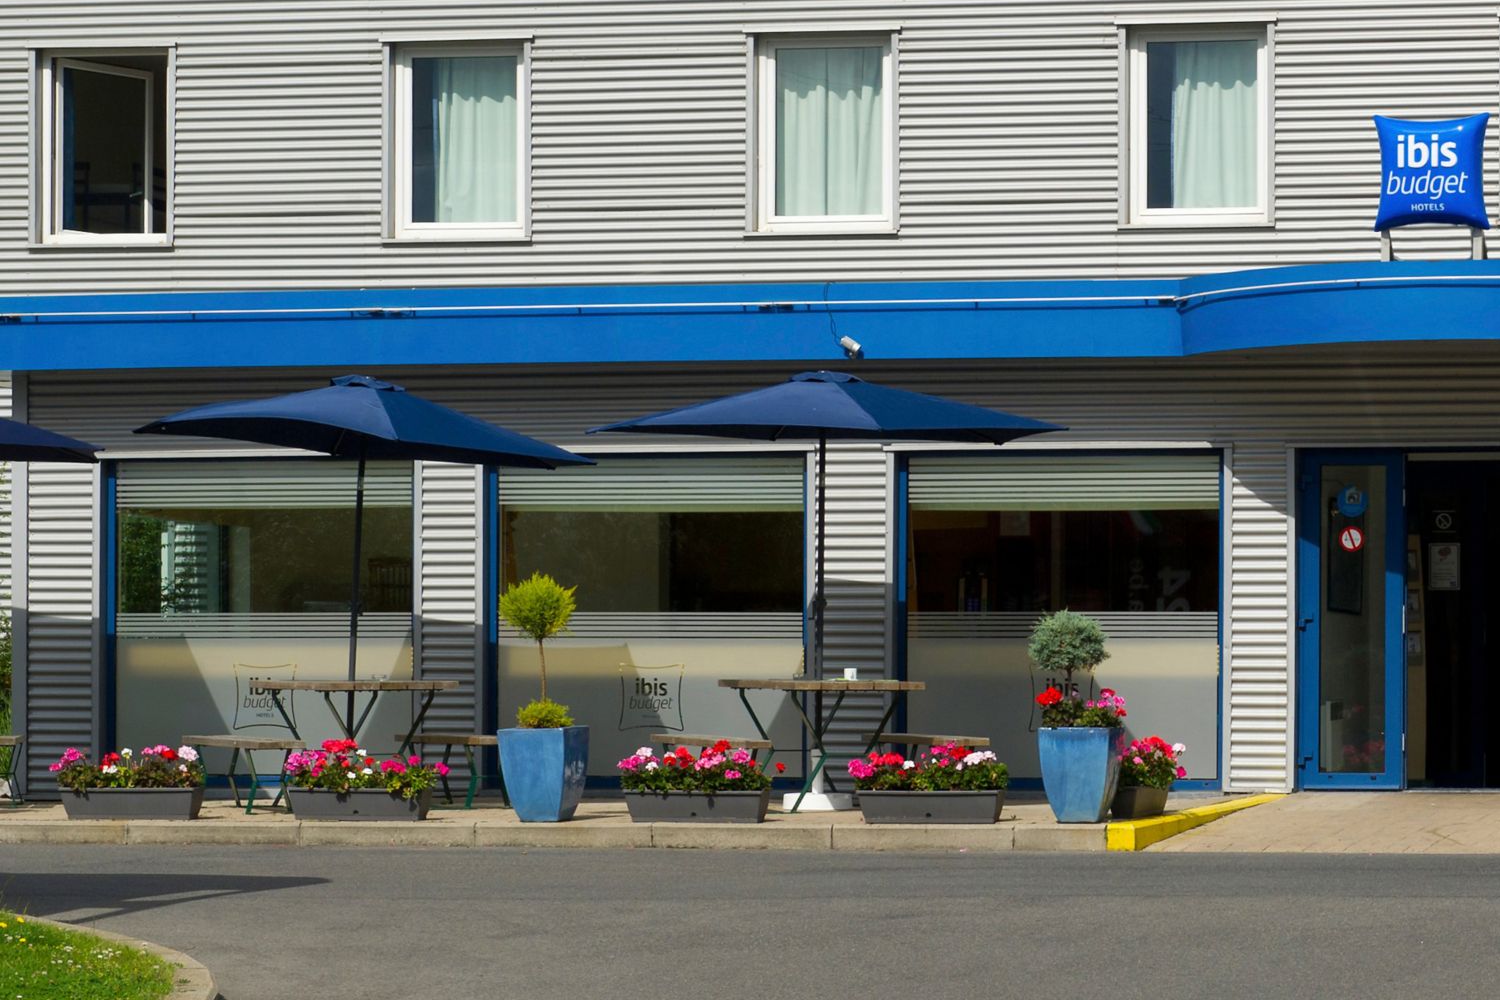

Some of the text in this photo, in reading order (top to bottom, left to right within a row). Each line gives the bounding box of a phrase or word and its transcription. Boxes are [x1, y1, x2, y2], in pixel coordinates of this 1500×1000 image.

[1397, 133, 1458, 168] ibis
[1386, 170, 1468, 200] budget
[1411, 203, 1445, 211] HOTELS
[635, 678, 668, 696] ibis
[243, 695, 286, 711] budgt
[629, 696, 673, 712] budget
